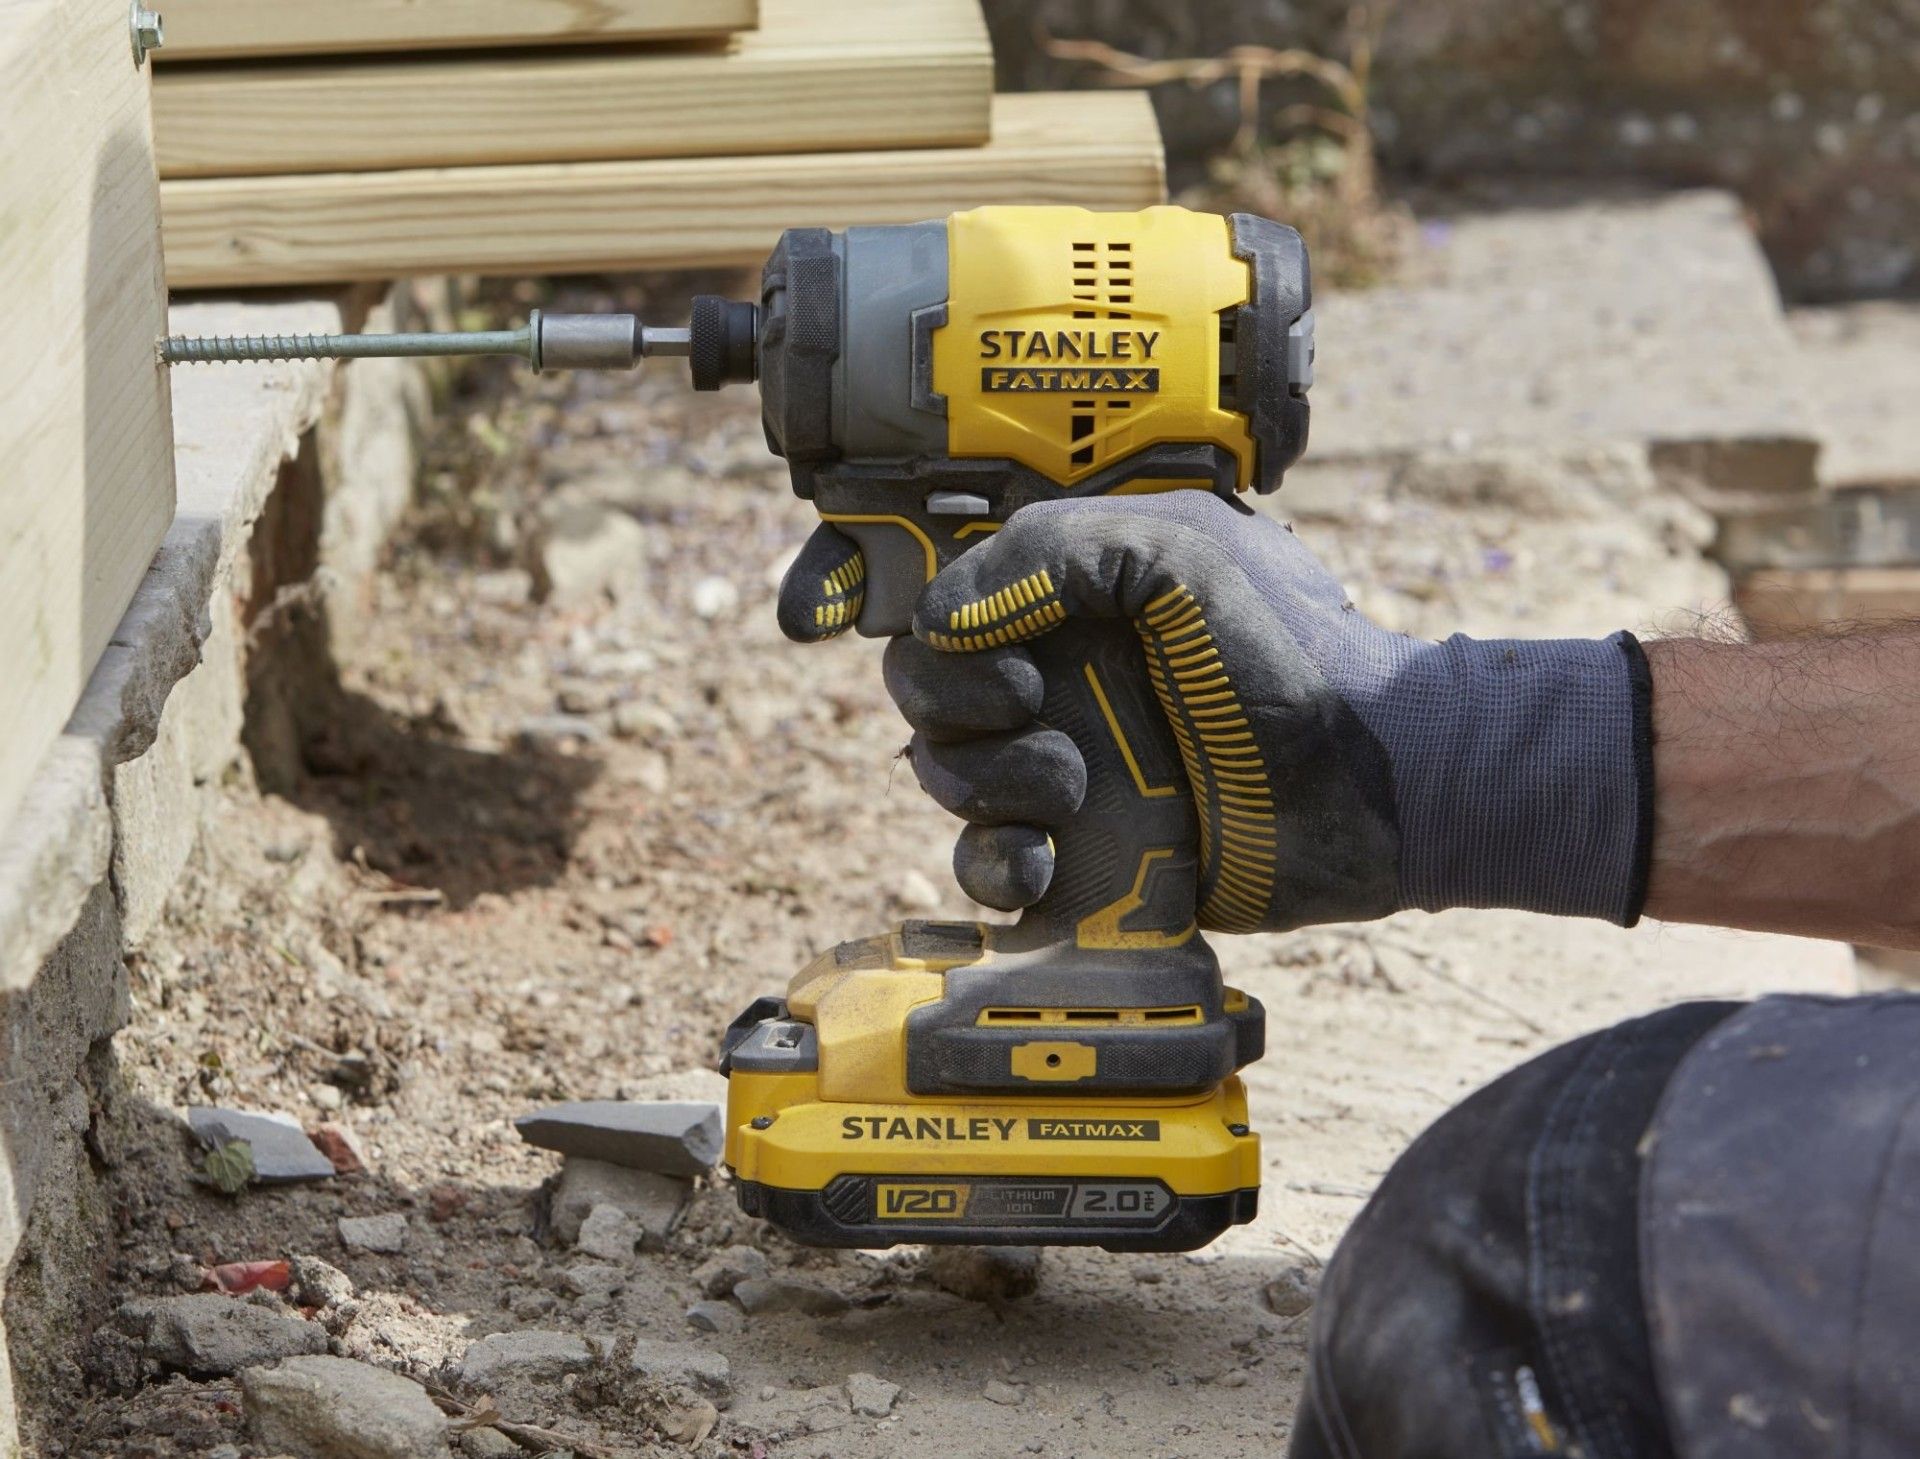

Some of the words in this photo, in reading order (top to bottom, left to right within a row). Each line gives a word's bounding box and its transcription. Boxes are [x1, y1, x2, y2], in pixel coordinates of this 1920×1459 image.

[980, 330, 1160, 358] STANLEY
[991, 370, 1149, 389] FATMAX
[841, 1116, 1018, 1141] STANLEY
[1040, 1123, 1145, 1138] FATMAX
[886, 1189, 958, 1214] V20
[1083, 1190, 1140, 1212] 2.0
